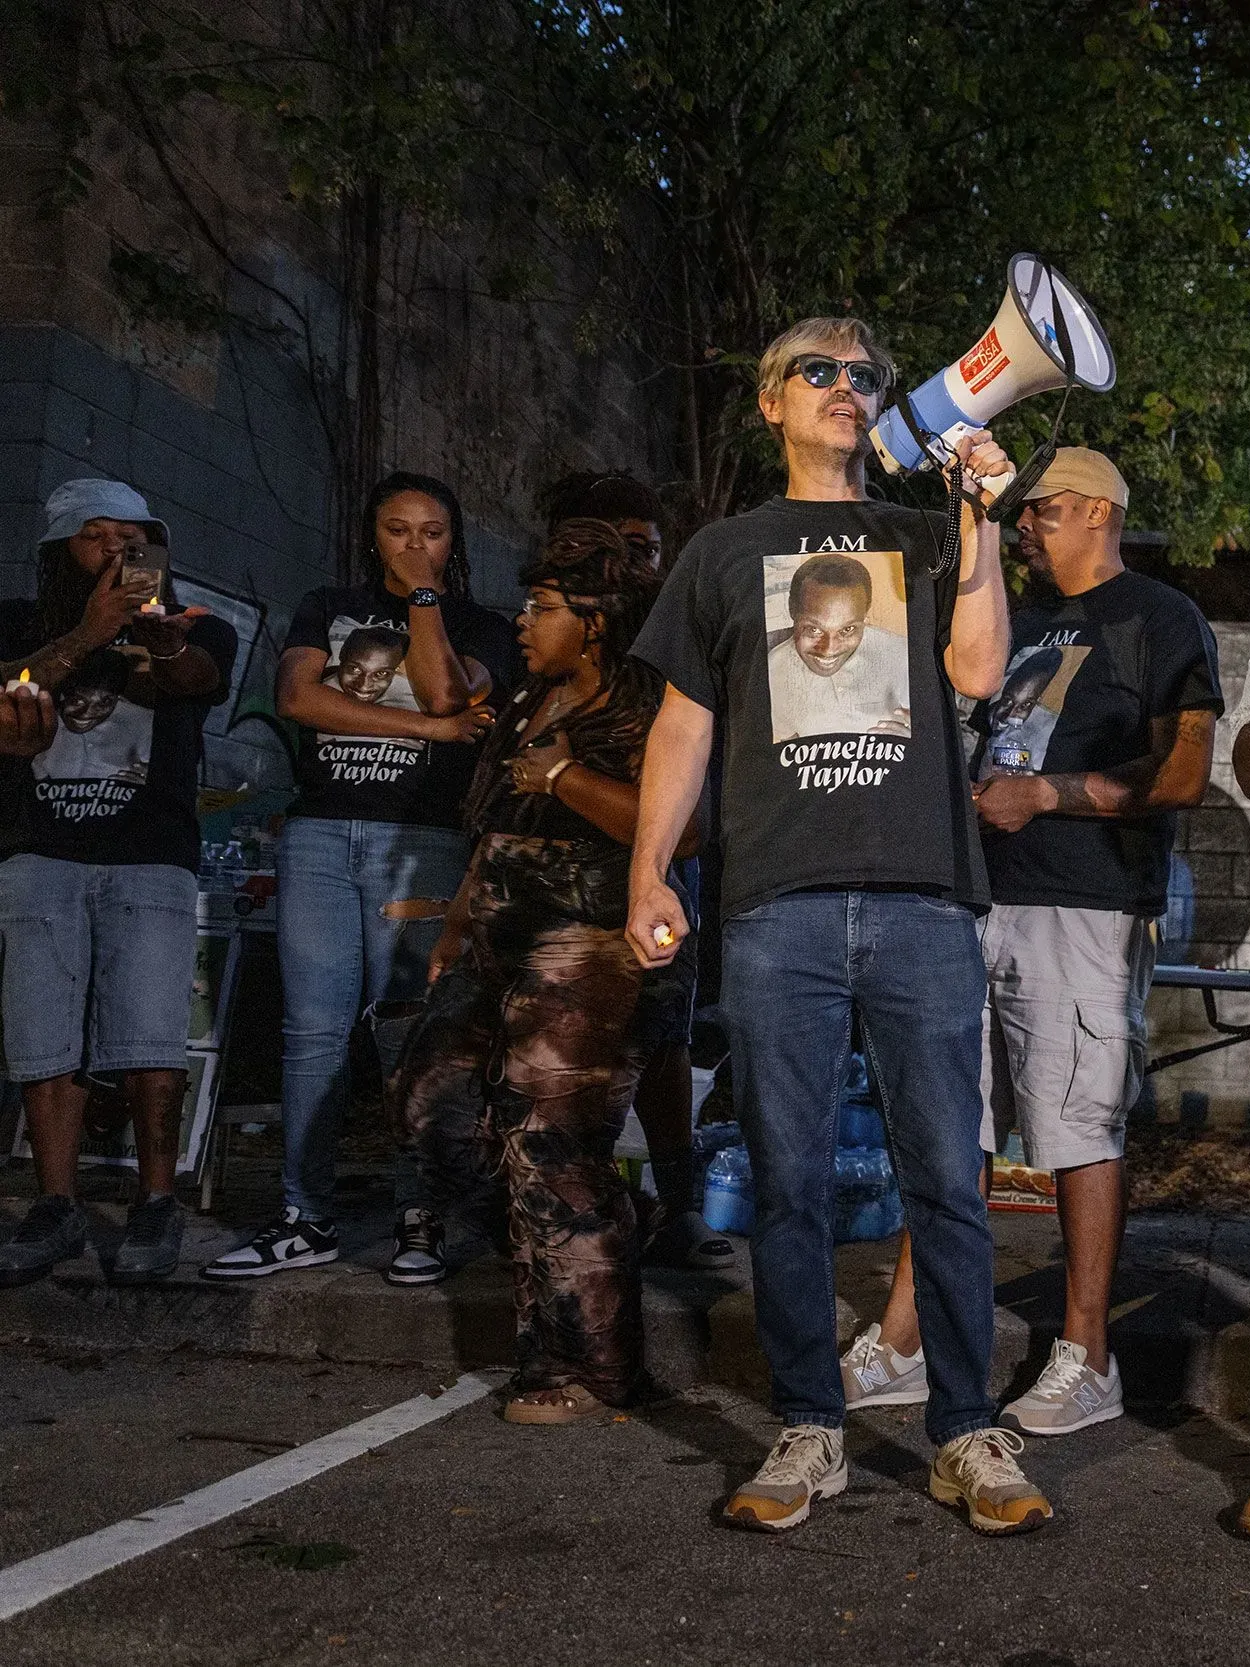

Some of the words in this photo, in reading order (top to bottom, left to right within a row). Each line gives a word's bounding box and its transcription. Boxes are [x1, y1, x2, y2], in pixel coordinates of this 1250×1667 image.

[979, 342, 1000, 367] DSA
[798, 537, 810, 554] I
[816, 534, 868, 552] AM
[364, 614, 376, 625] I
[1037, 631, 1051, 647] I
[1047, 630, 1080, 646] AM
[318, 743, 419, 766] Cornelius
[780, 735, 906, 767] Cornelius
[1000, 758, 1020, 766] PARK
[1001, 751, 1020, 760] DEER
[331, 762, 404, 785] Taylor
[797, 760, 890, 794] Taylor
[35, 780, 136, 801] Cornelius
[52, 798, 125, 823] Taylor
[853, 1359, 890, 1392] N
[1071, 1382, 1101, 1415] N
